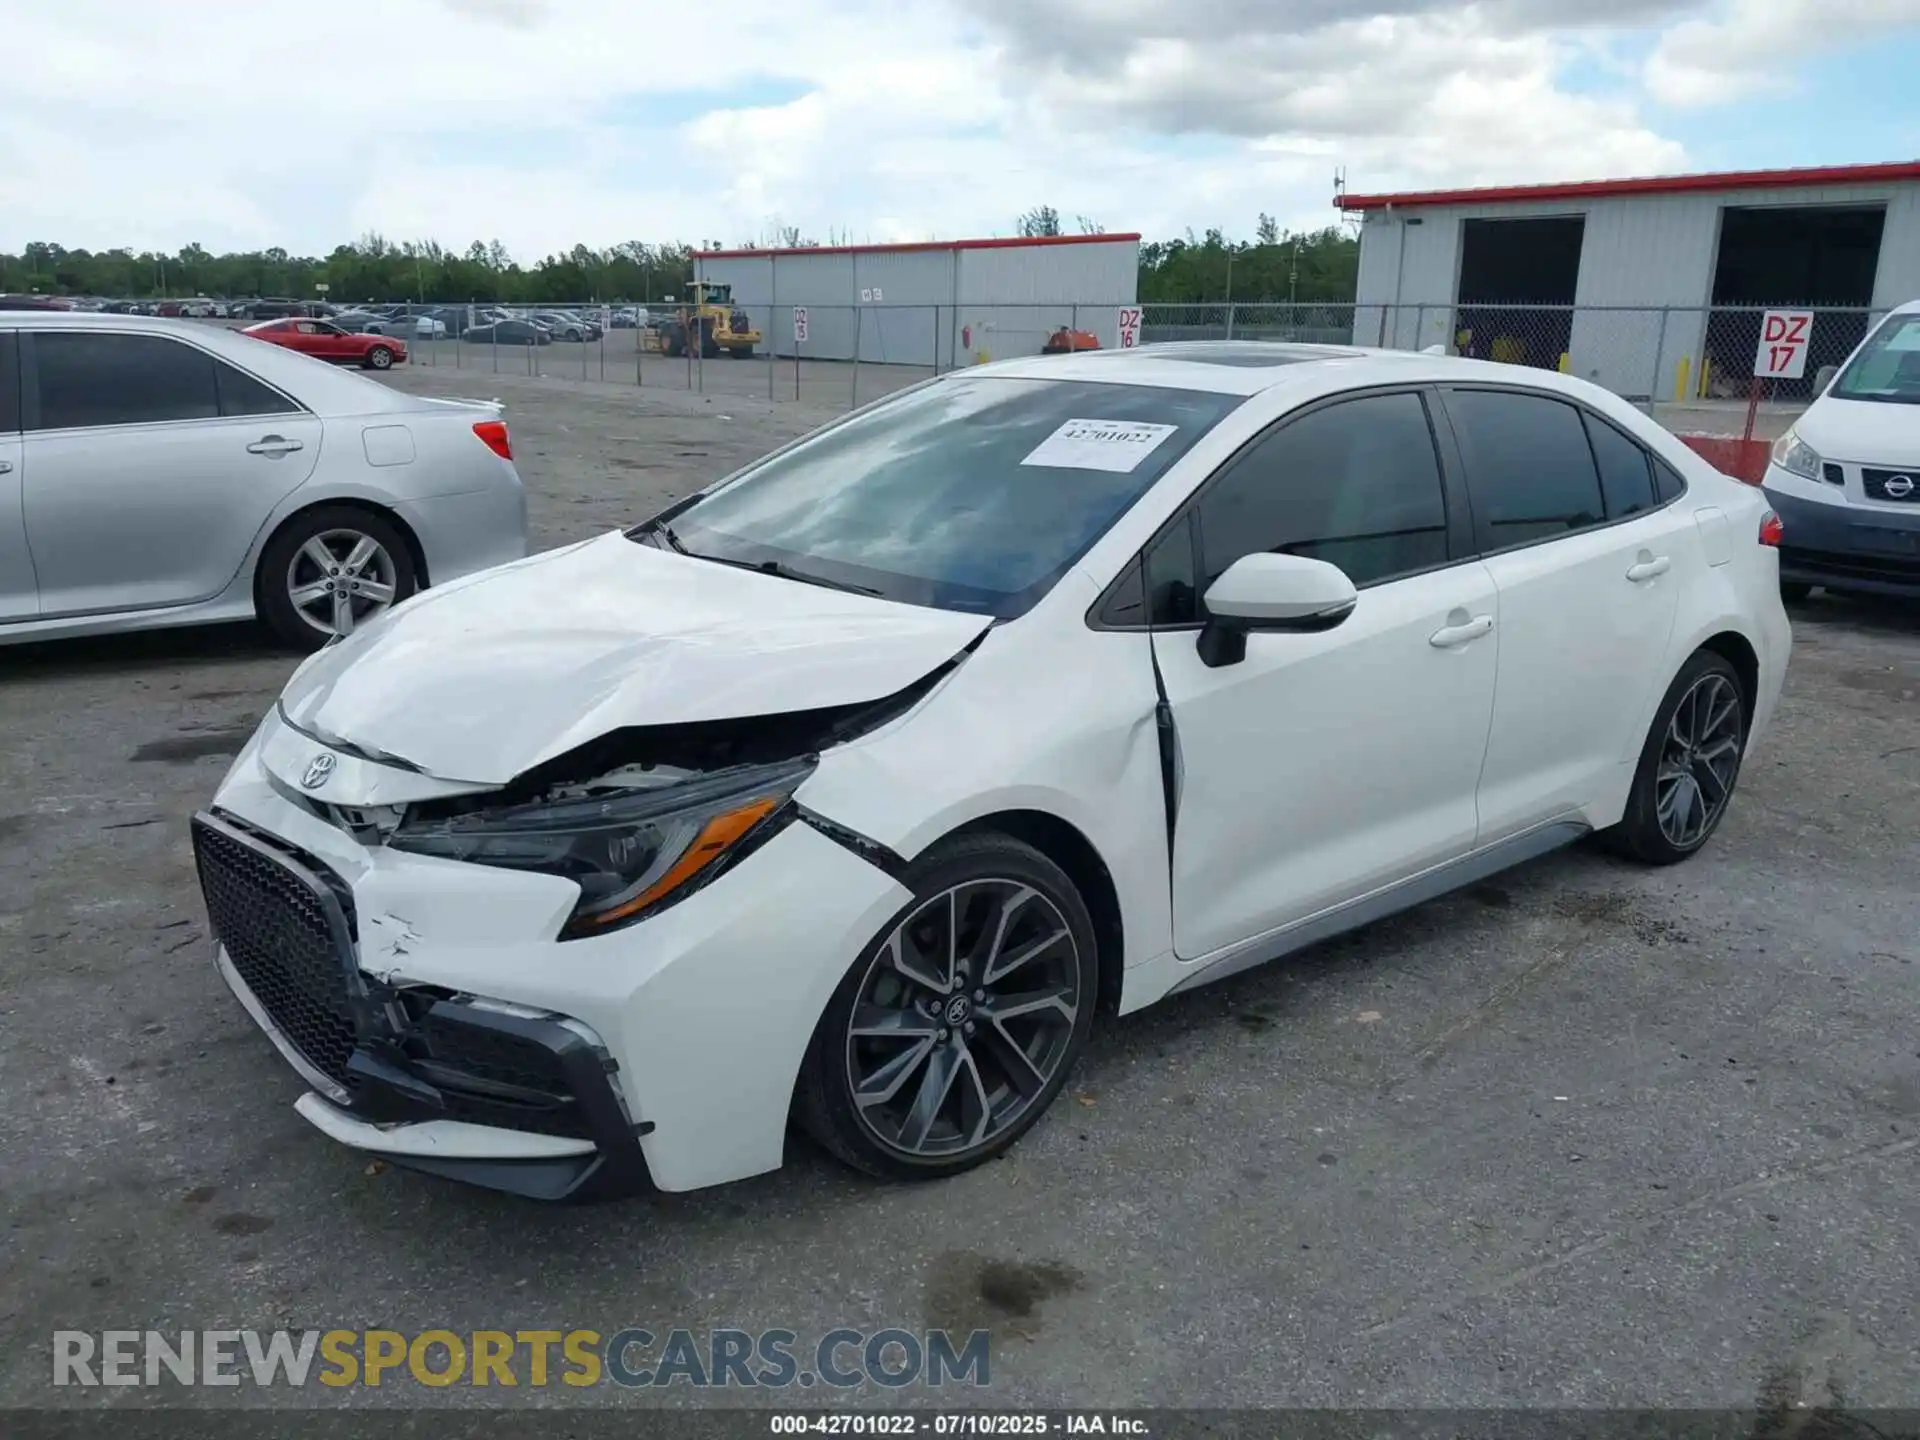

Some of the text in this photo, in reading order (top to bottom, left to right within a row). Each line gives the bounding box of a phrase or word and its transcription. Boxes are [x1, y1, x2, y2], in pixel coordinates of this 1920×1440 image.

[1120, 310, 1139, 328] DZ
[1765, 316, 1809, 343] DZ
[1121, 331, 1133, 348] 16
[1769, 346, 1795, 372] 17
[1064, 430, 1152, 442] 42701022
